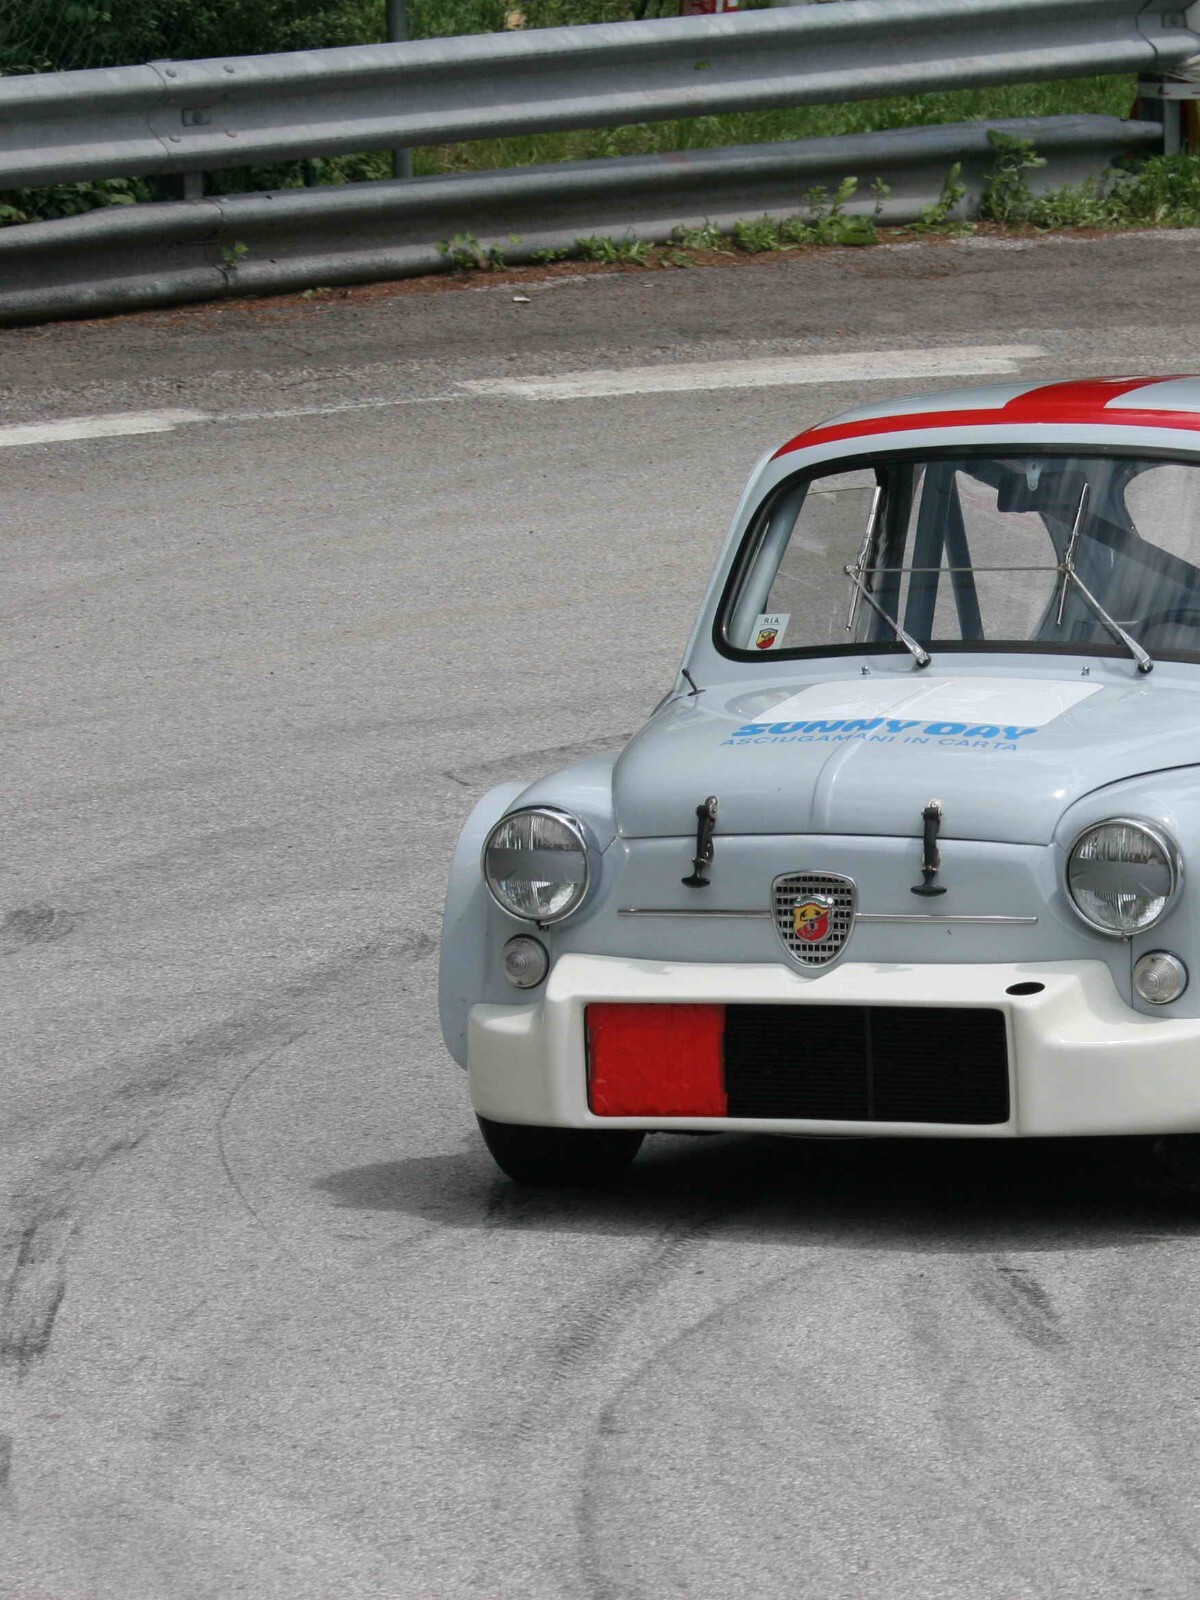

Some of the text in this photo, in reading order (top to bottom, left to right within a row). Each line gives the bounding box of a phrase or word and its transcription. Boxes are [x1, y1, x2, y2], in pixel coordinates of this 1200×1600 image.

[732, 717, 1038, 741] SUNNY DAY
[719, 732, 1018, 751] ASCIUGAMANI IN CARTA
